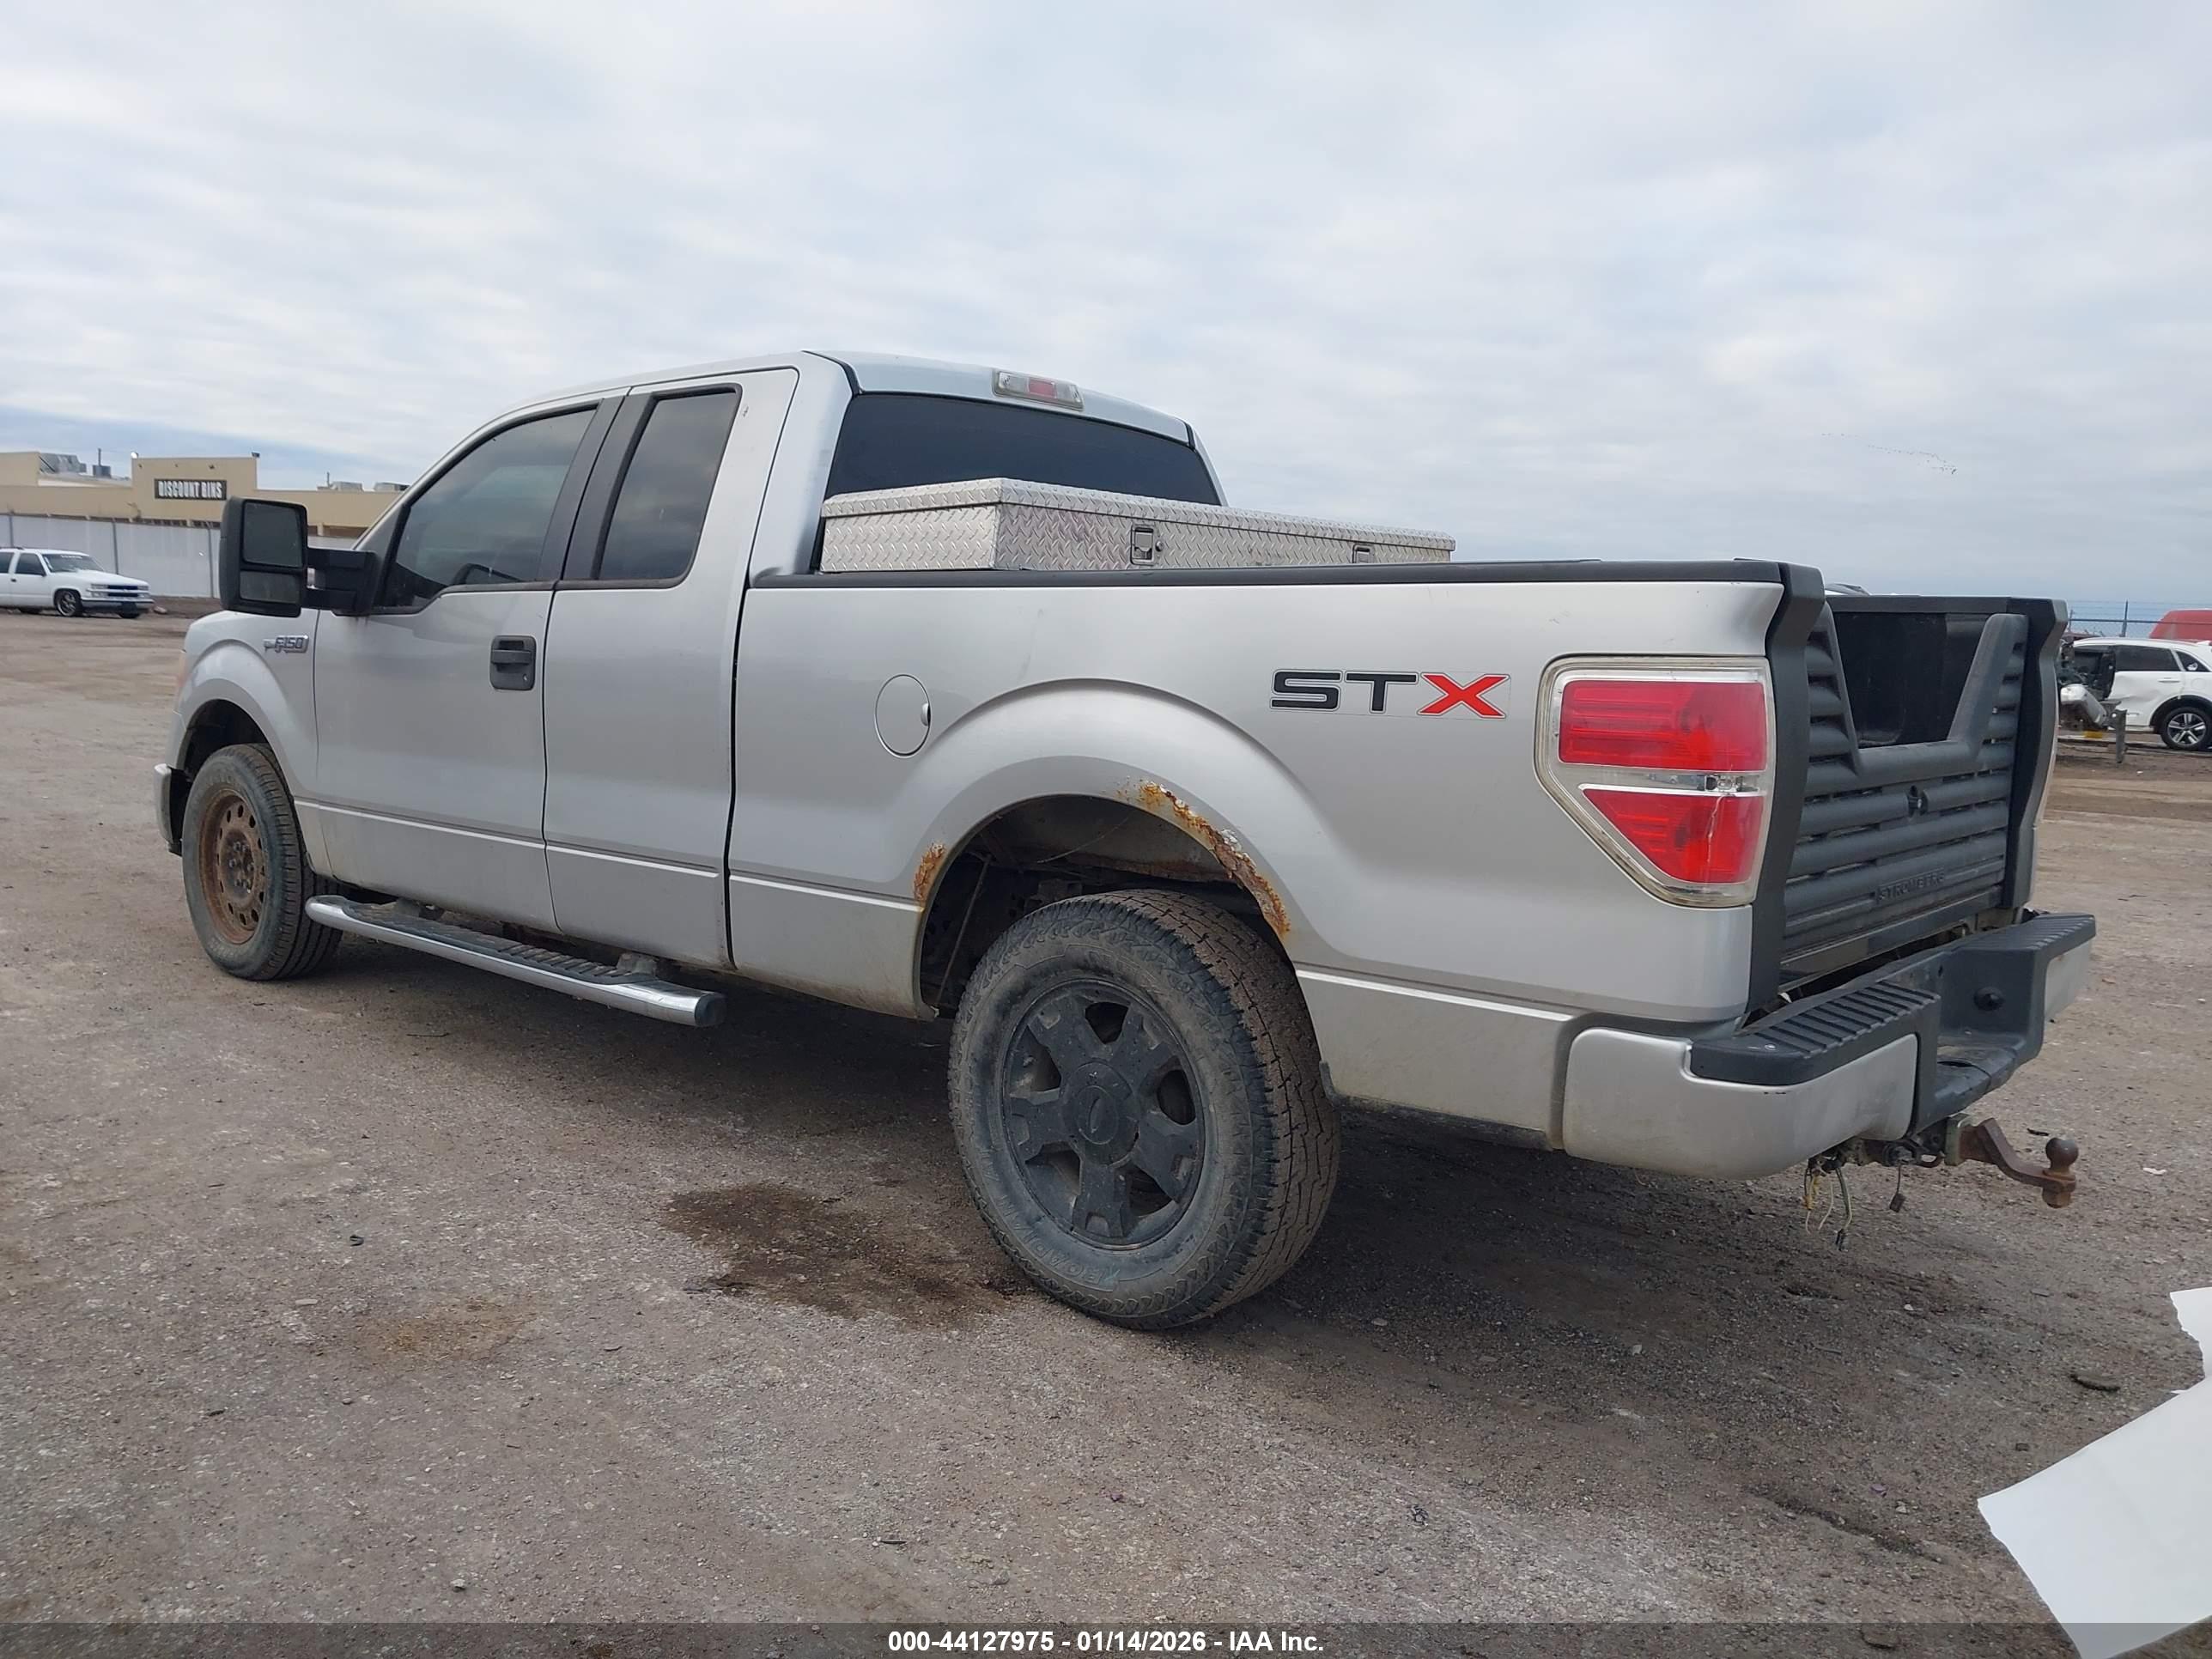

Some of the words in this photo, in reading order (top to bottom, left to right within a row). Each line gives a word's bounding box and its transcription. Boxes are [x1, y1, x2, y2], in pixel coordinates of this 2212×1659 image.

[158, 481, 199, 497] DISCOUNT
[201, 482, 222, 498] BINS
[1270, 669, 1510, 718] STX
